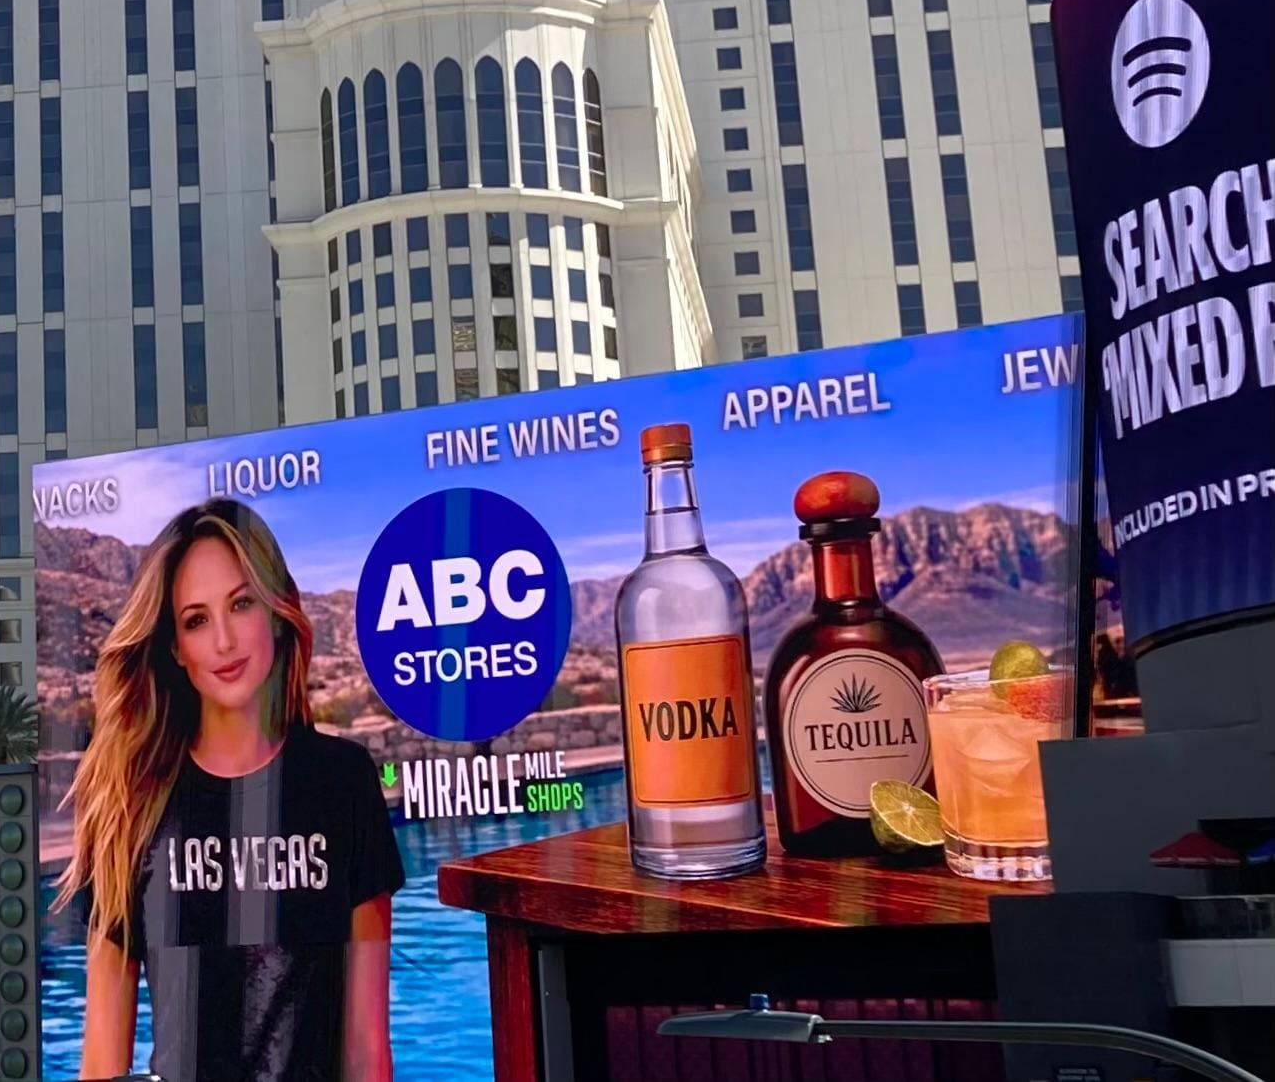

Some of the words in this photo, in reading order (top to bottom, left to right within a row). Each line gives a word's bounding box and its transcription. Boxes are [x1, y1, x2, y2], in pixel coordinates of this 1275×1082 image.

[1104, 158, 1275, 320] SEARCH
[1001, 344, 1079, 394] JEW
[722, 372, 890, 431] APPAREL
[426, 424, 500, 469] FINE
[508, 408, 620, 457] WINES
[209, 449, 322, 498] LIQUOR
[1199, 479, 1233, 511] IN
[376, 549, 546, 632] ABC
[393, 641, 539, 686] STORES
[638, 696, 740, 743] VODKA
[804, 717, 918, 751] TEQUILA
[402, 754, 524, 819] MIRACLE
[525, 750, 567, 780] MILE
[527, 782, 584, 813] SHOPS
[169, 835, 223, 892] LAS
[230, 832, 329, 892] VEGAS
